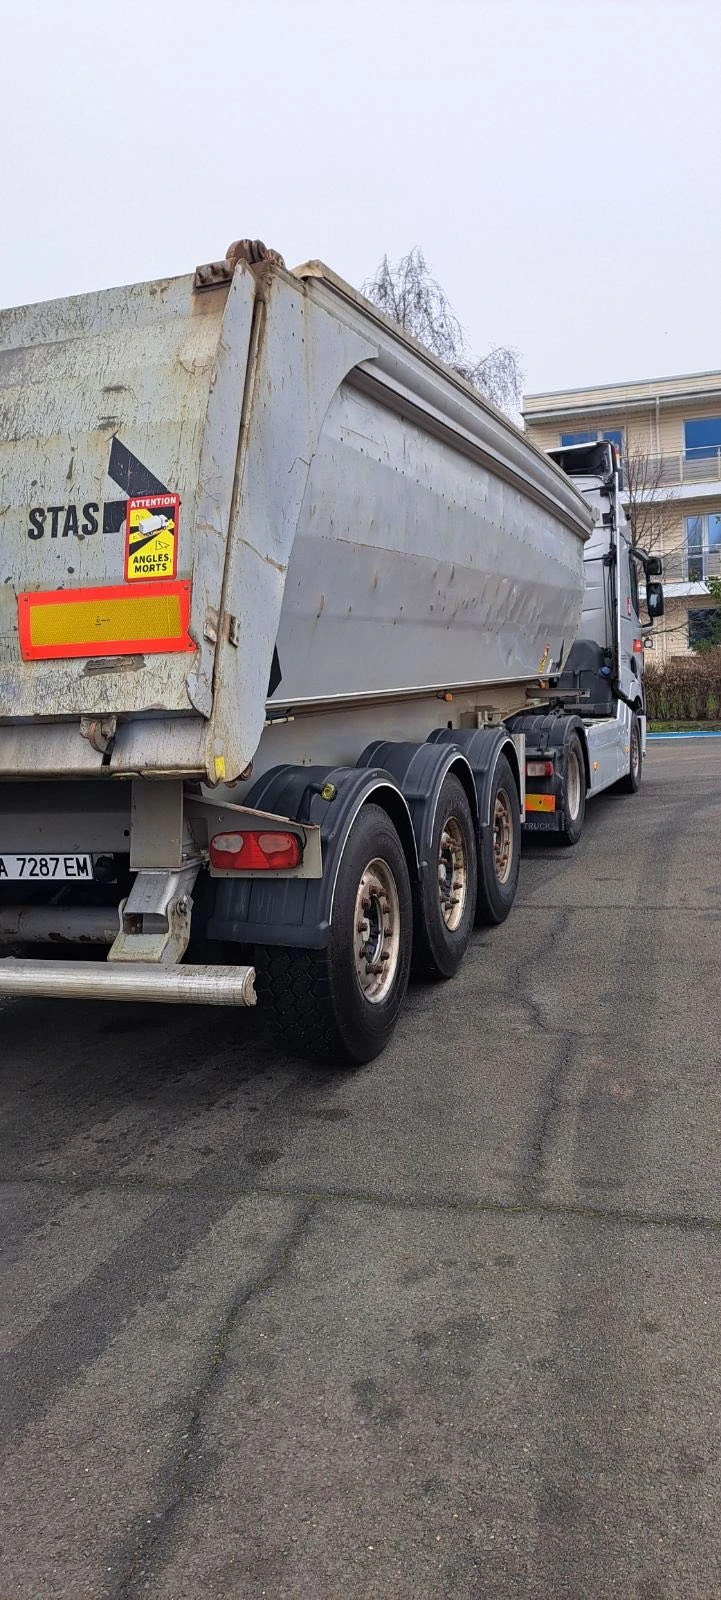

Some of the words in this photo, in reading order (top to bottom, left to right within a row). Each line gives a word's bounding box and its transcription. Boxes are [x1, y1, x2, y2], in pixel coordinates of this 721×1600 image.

[130, 497, 177, 508] ATTENTION
[27, 502, 100, 540] STAS
[132, 553, 169, 564] ANGLES
[134, 563, 167, 573] MORTS
[16, 857, 60, 877] 7287
[63, 857, 89, 877] EM
